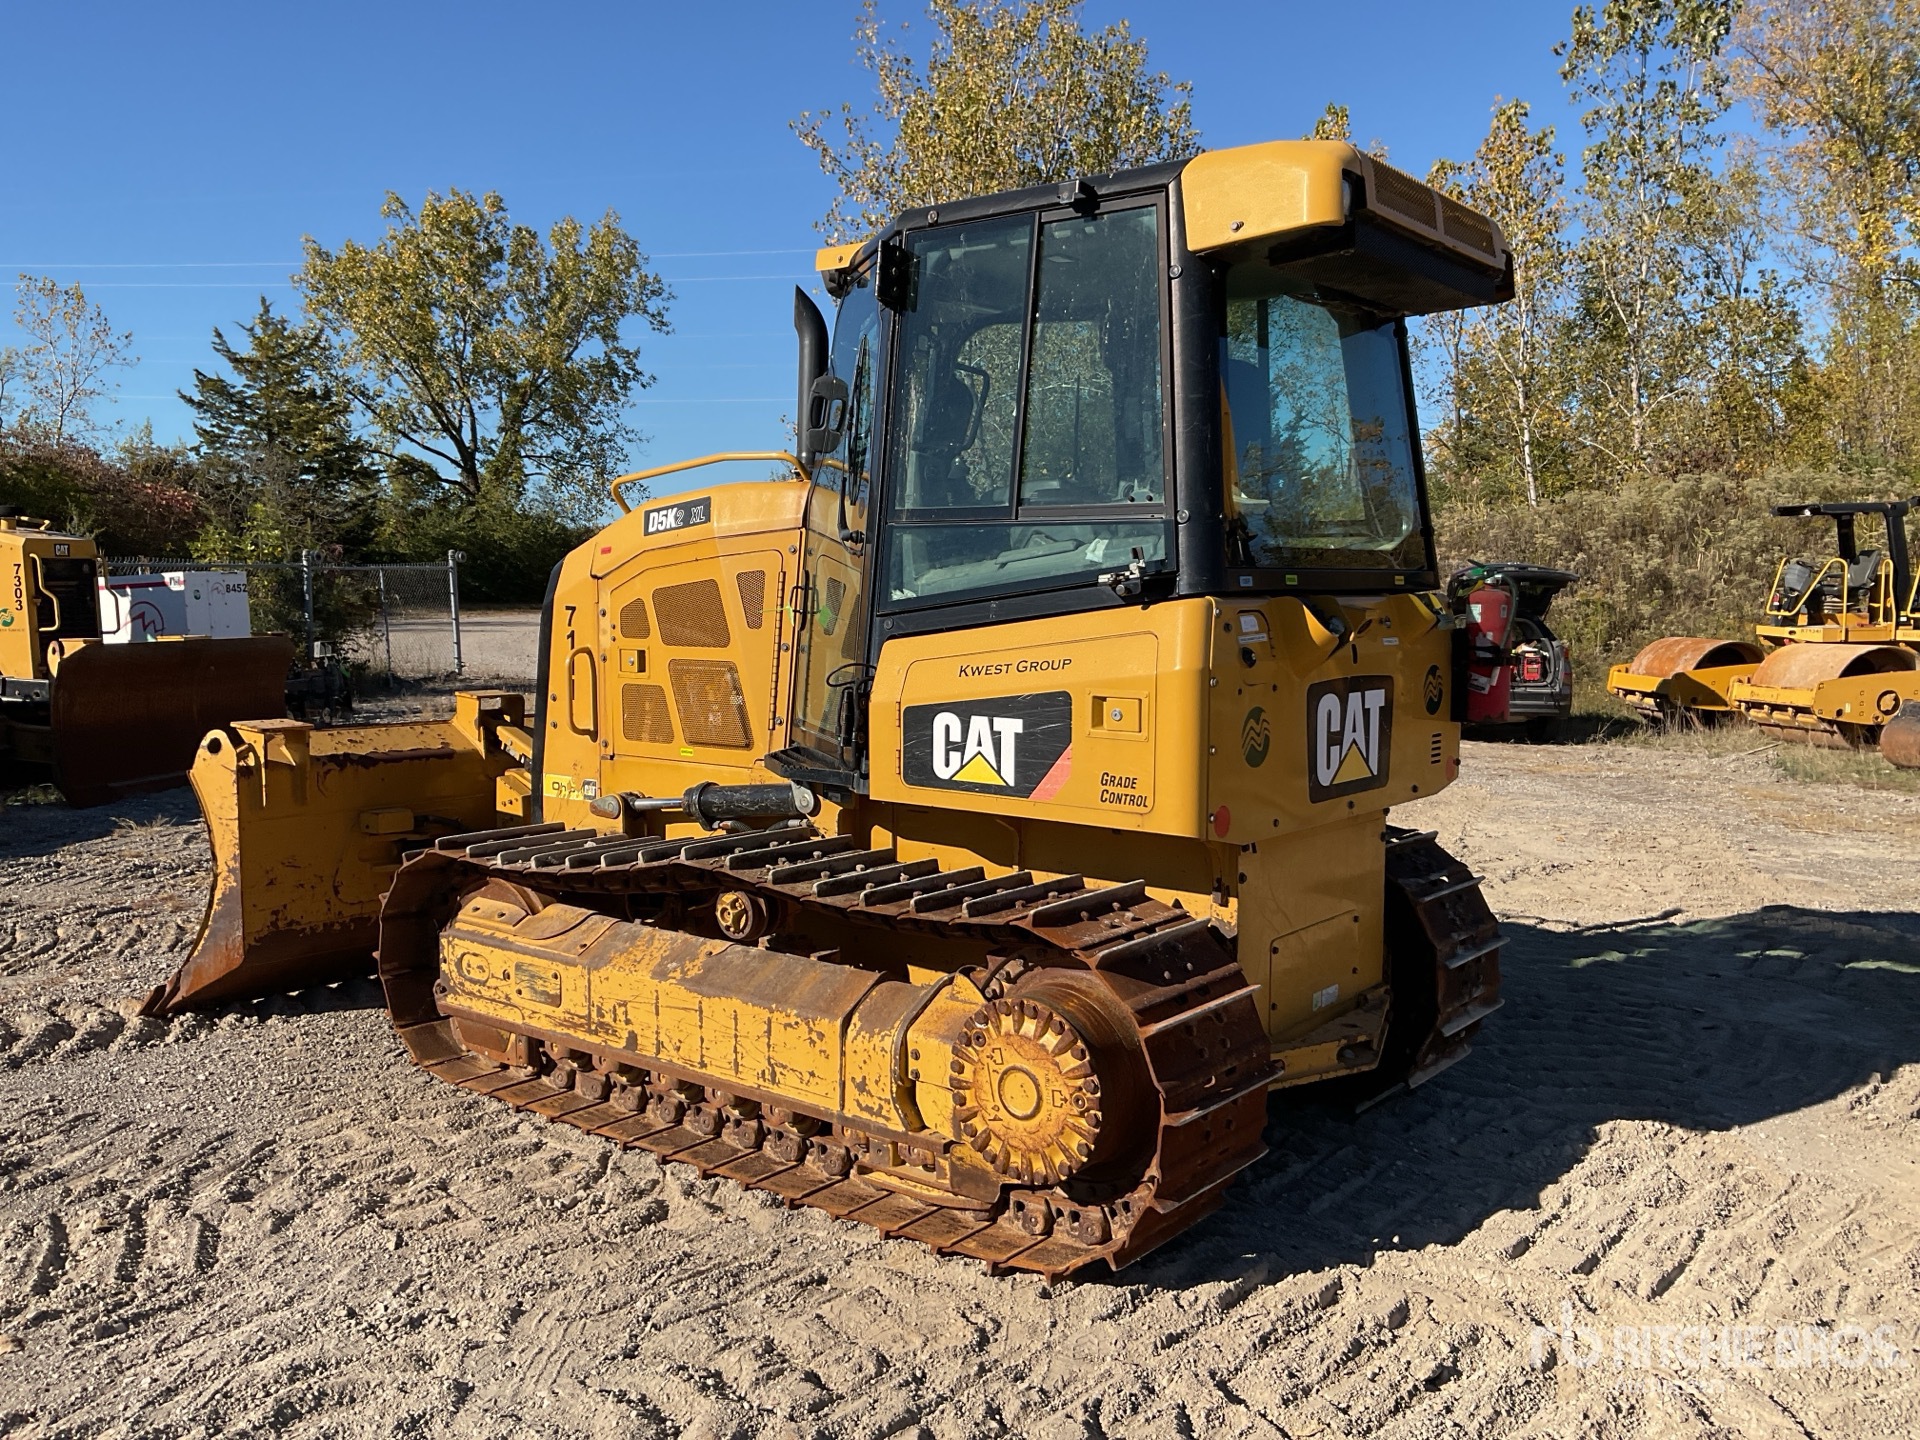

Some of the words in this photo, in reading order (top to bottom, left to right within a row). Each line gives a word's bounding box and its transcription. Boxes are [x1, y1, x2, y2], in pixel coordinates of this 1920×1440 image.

[648, 507, 685, 533] D5K2
[689, 505, 706, 524] XL
[55, 544, 69, 556] CAT
[225, 583, 248, 593] 8452
[958, 662, 1012, 678] KWEST
[1016, 658, 1072, 673] GROUP
[1316, 688, 1385, 787] CAT
[932, 711, 1023, 787] CAT
[1100, 771, 1138, 789] GRADE
[1100, 789, 1149, 808] CONTROL
